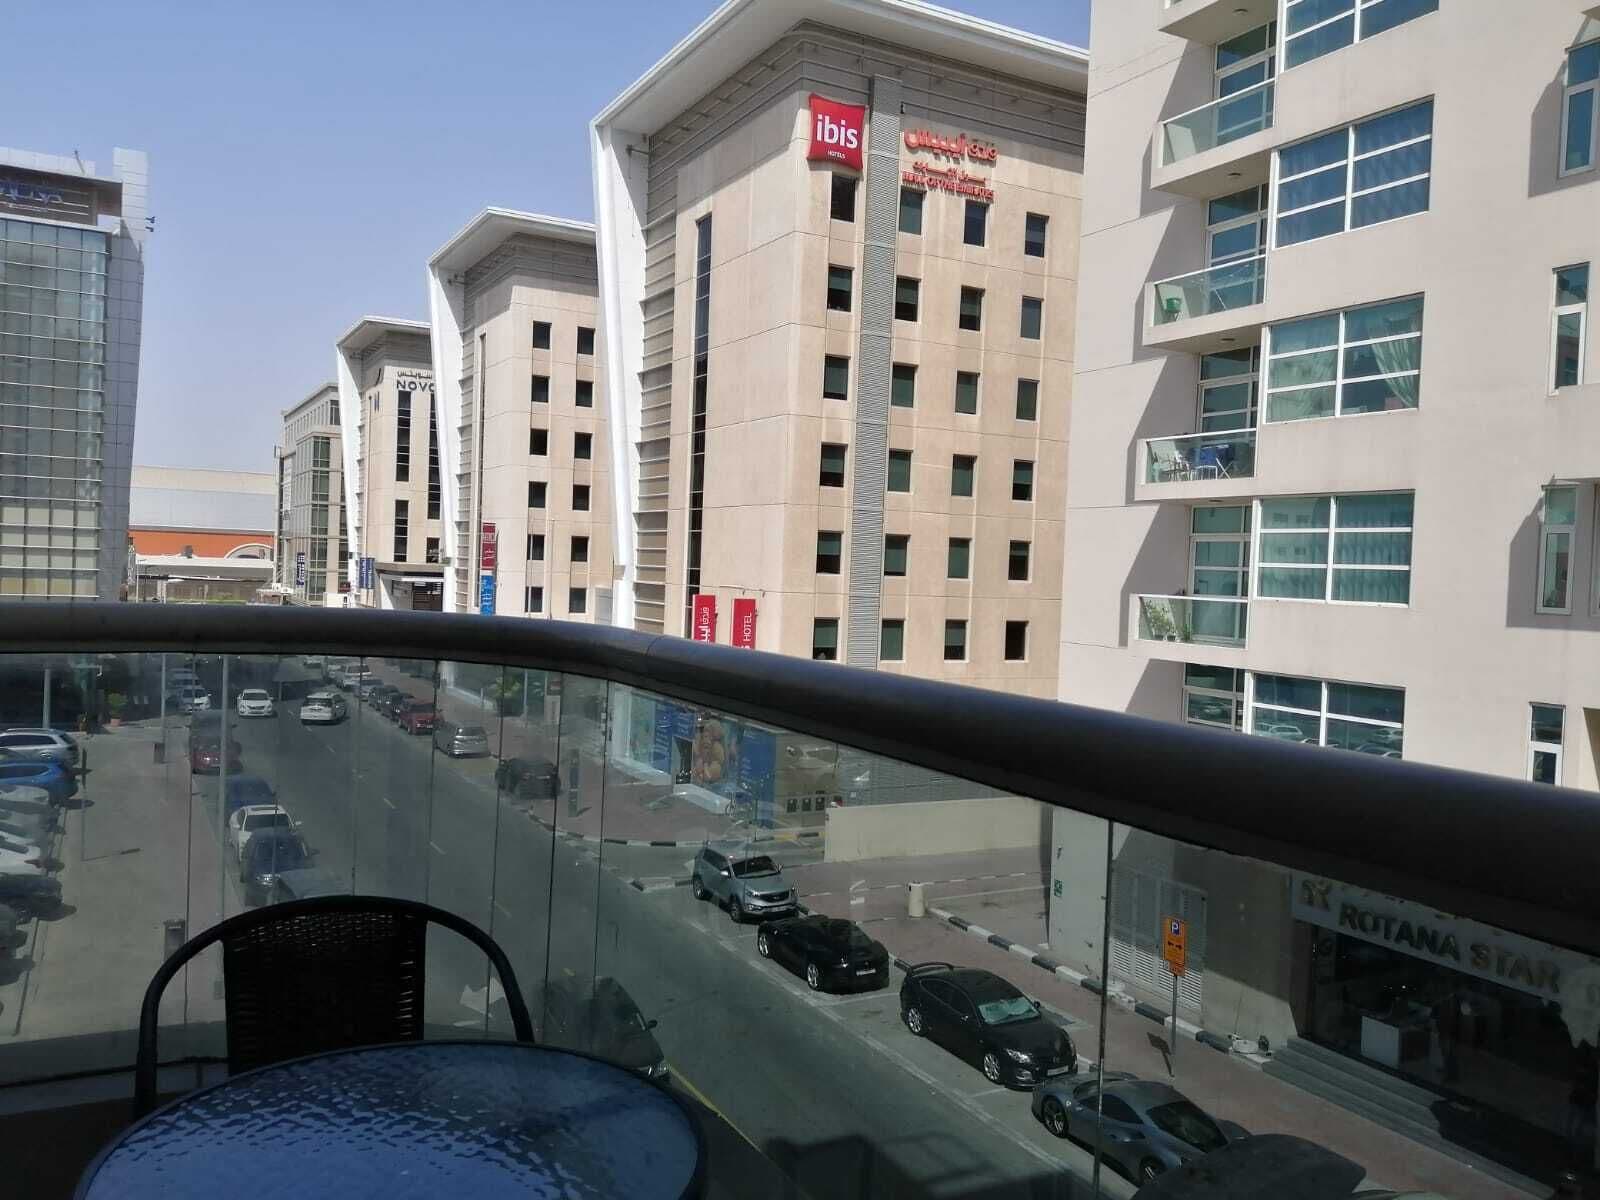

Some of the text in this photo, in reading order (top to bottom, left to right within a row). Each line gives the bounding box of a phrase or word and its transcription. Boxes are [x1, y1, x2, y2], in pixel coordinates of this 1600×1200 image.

[816, 113, 858, 149] ibis
[827, 149, 846, 159] HOTELS
[743, 612, 752, 642] HOTEL
[1339, 903, 1561, 995] ROTANA STAR
